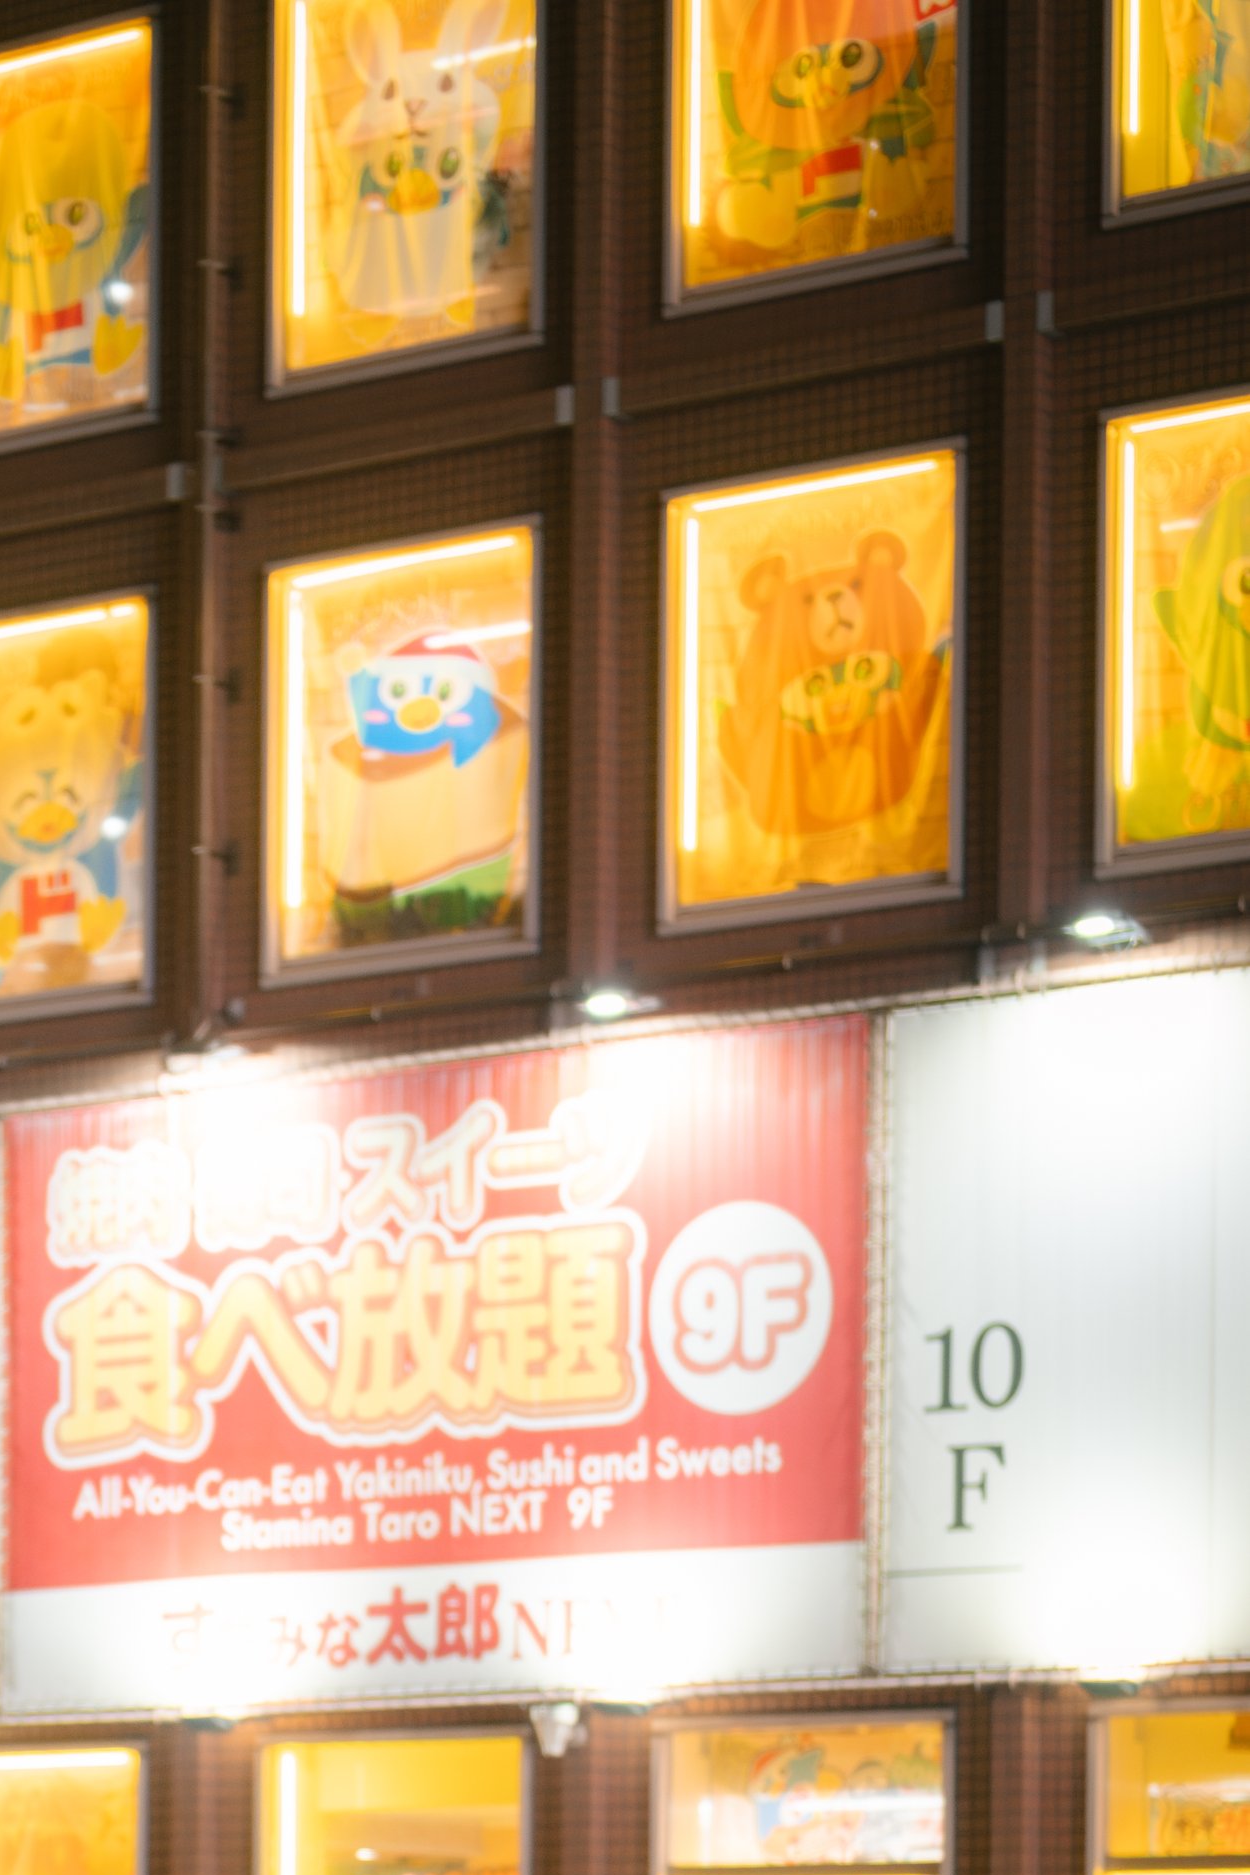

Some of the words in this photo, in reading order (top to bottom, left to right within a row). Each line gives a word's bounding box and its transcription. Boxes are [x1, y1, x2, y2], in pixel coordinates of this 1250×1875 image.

[48, 1212, 643, 1464] 食べ放題
[676, 1253, 812, 1373] 9F
[923, 1321, 1024, 1414] 10
[73, 1465, 327, 1520] All-You-Can-Eat
[336, 1452, 483, 1500] Yakiniku,
[487, 1444, 573, 1490] Sushi
[580, 1436, 648, 1485] and
[656, 1436, 782, 1480] Sweets
[221, 1508, 354, 1552] Stamina
[361, 1501, 440, 1542] Taro
[451, 1490, 547, 1537] NEXT
[567, 1486, 614, 1530] 9F
[948, 1443, 1006, 1532] F
